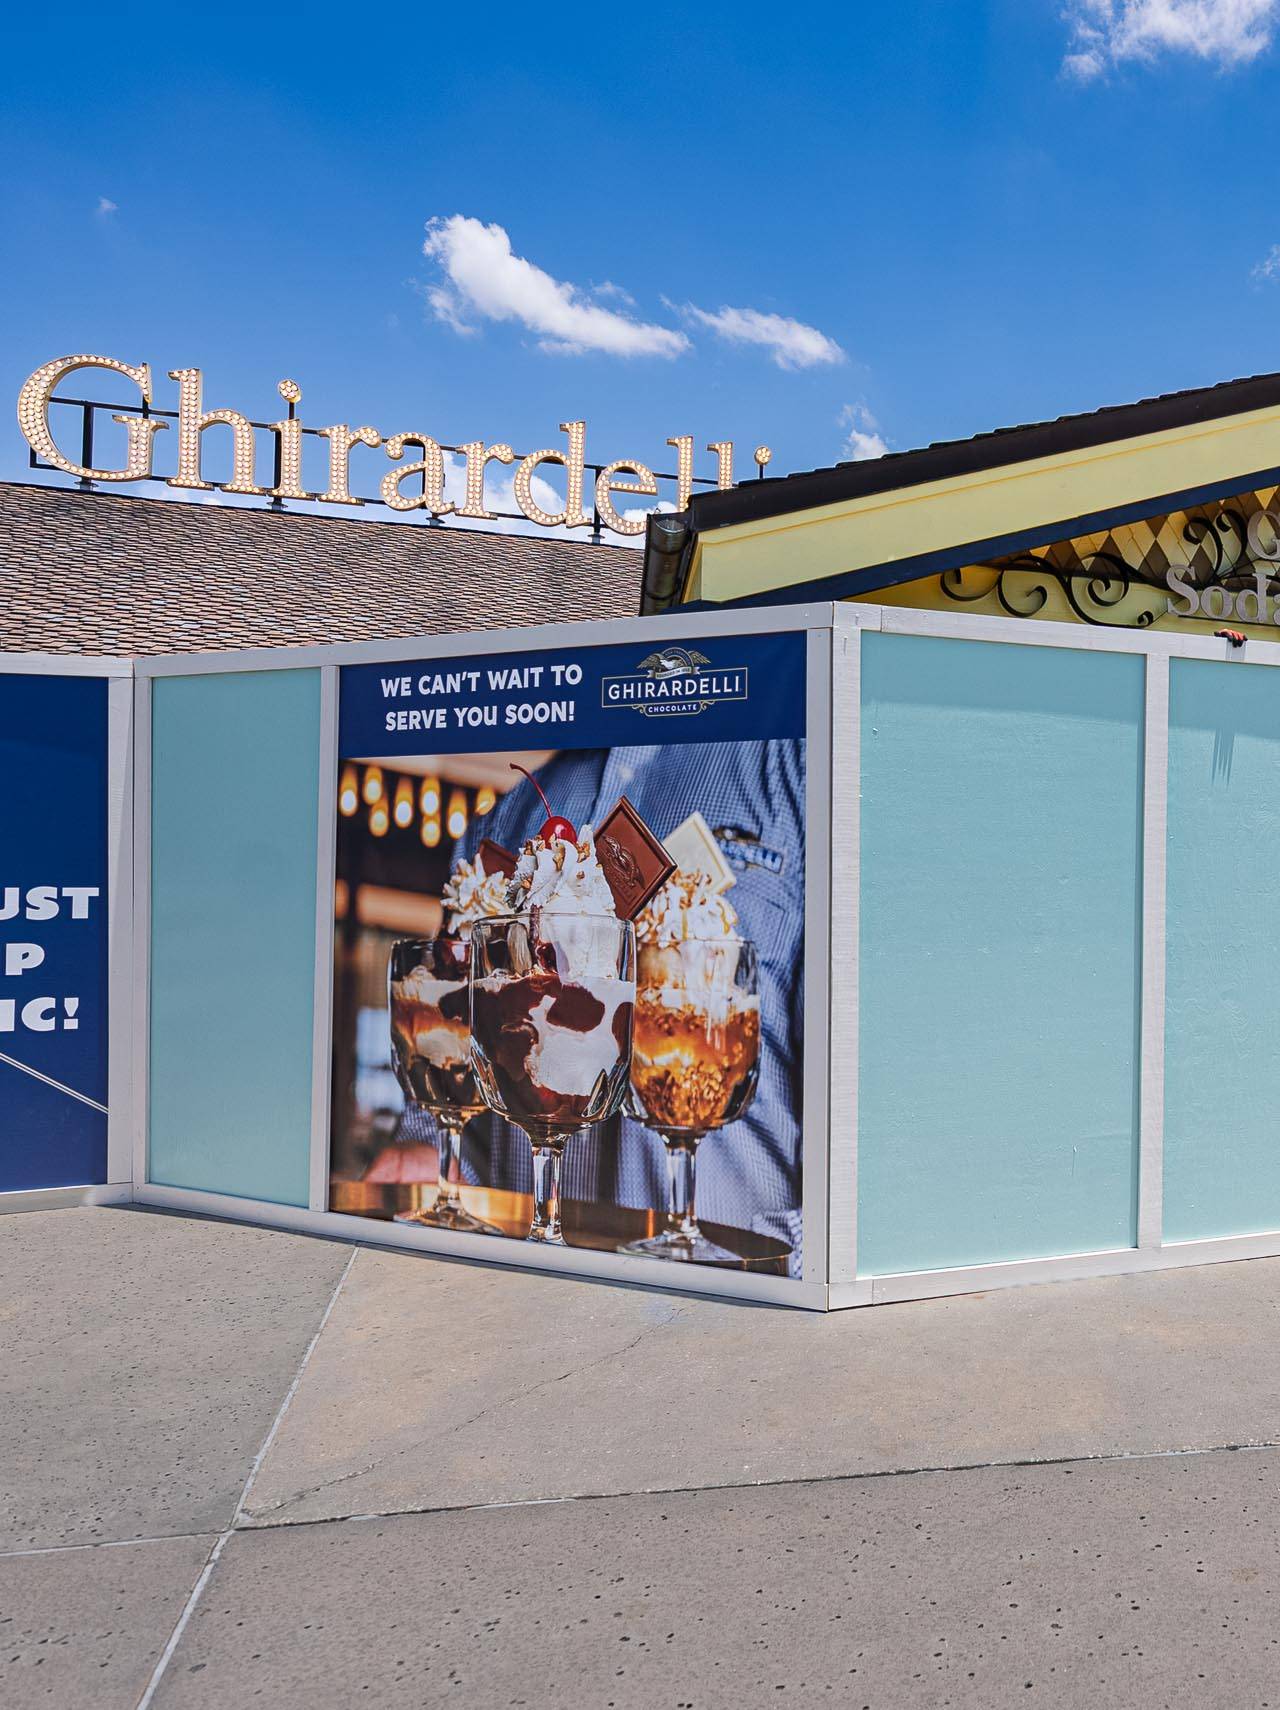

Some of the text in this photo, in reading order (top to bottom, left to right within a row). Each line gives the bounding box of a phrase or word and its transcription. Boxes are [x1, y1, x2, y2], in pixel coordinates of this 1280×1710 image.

[17, 354, 771, 535] Ghirardel
[380, 664, 583, 697] WE CAN'T WAIT TO
[608, 676, 739, 700] GHIRARDELLI
[385, 701, 575, 731] SERVE YOU SOON!
[648, 704, 697, 713] CHOCOLATE
